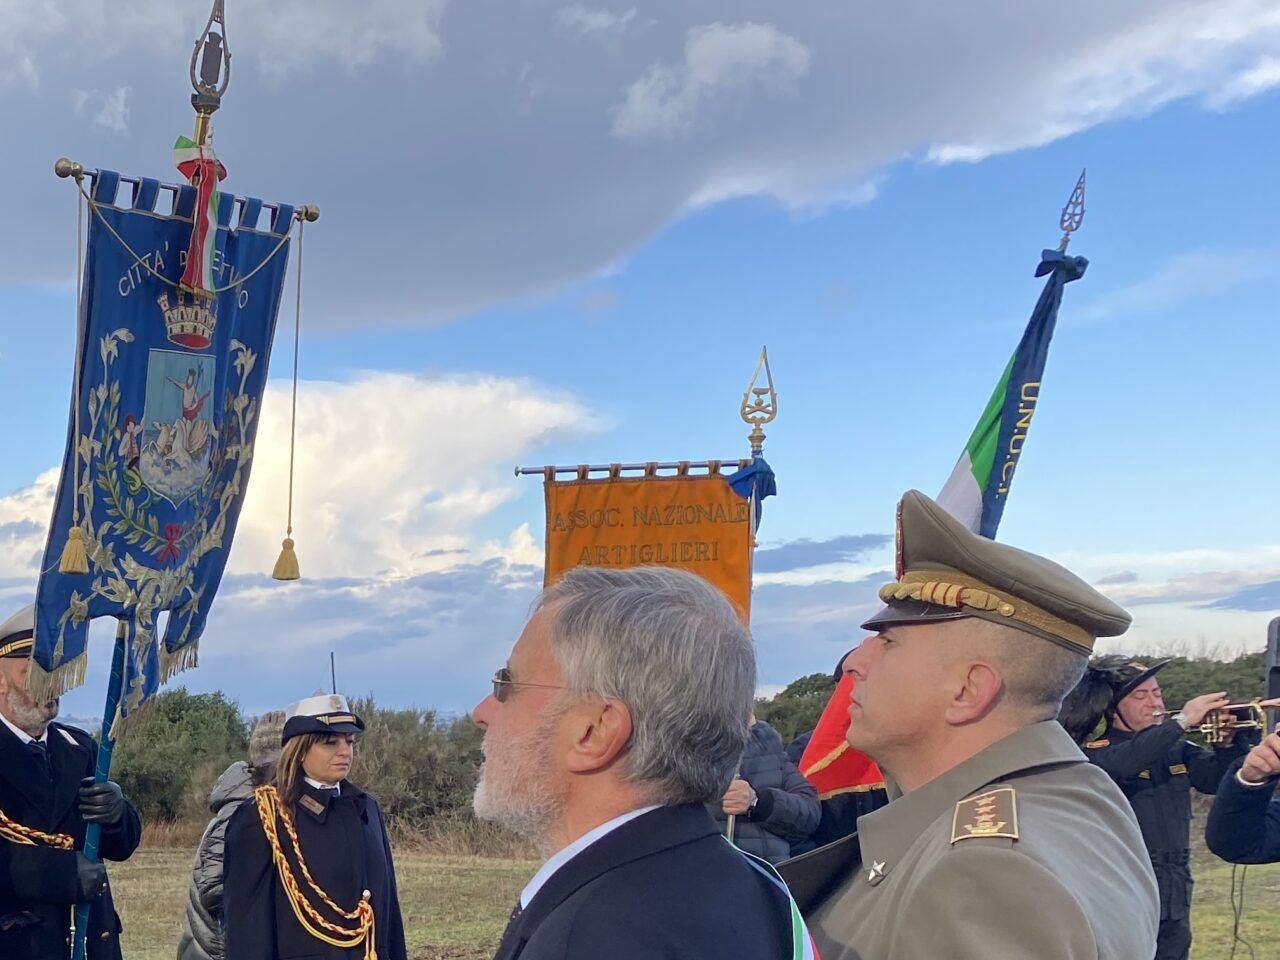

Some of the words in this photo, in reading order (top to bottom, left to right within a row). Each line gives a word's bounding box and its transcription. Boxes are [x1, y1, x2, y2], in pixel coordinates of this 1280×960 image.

[552, 507, 623, 532] ASSOC.
[632, 502, 749, 528] NAZIONALE
[577, 540, 719, 566] ARTIGLIERI
